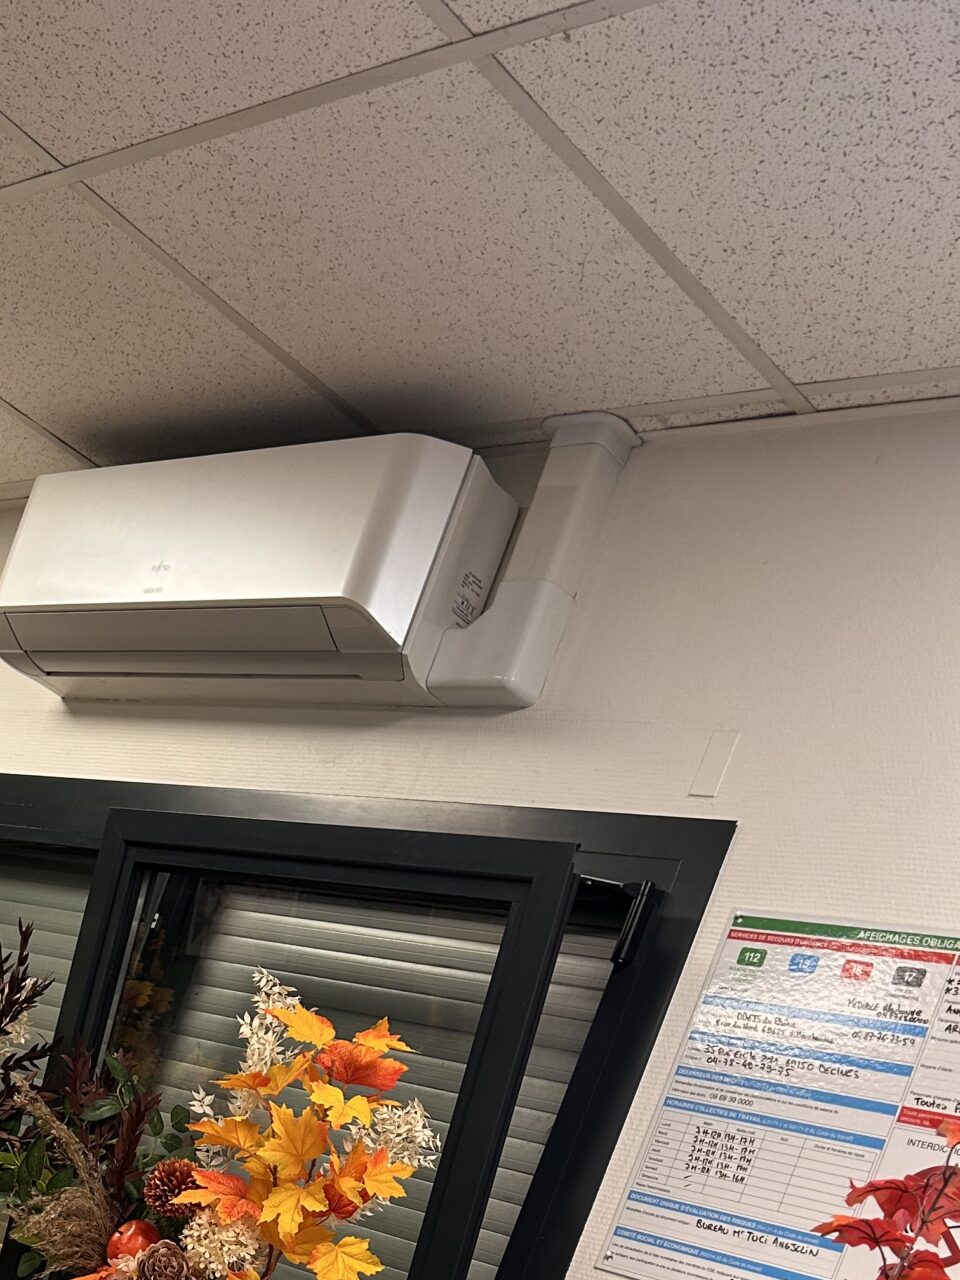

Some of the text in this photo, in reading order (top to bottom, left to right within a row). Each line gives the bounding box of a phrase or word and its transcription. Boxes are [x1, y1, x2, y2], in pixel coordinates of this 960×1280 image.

[730, 931, 758, 940] SERVICES
[767, 936, 794, 944] SECOURS
[744, 951, 760, 963] 112
[903, 971, 917, 983] 17
[704, 1044, 718, 1054] 35
[785, 1058, 814, 1071] 69150
[818, 1063, 860, 1079] DECINES
[709, 1092, 718, 1100] 09
[666, 1099, 695, 1110] HORAIRES
[694, 1104, 729, 1117] COLLECTIFS
[630, 1192, 659, 1205] DOCUMENT
[659, 1199, 680, 1210] UNIQUE
[680, 1203, 720, 1218] D'ÉVALUATION
[719, 1213, 731, 1222] DES
[731, 1217, 756, 1228] RISQUES
[696, 1218, 729, 1235] BUREAU
[616, 1228, 636, 1239] COMITÉ
[636, 1233, 656, 1244] SOCIAL
[656, 1237, 664, 1245] ET
[663, 1239, 699, 1254] ÉCONOMIQUE
